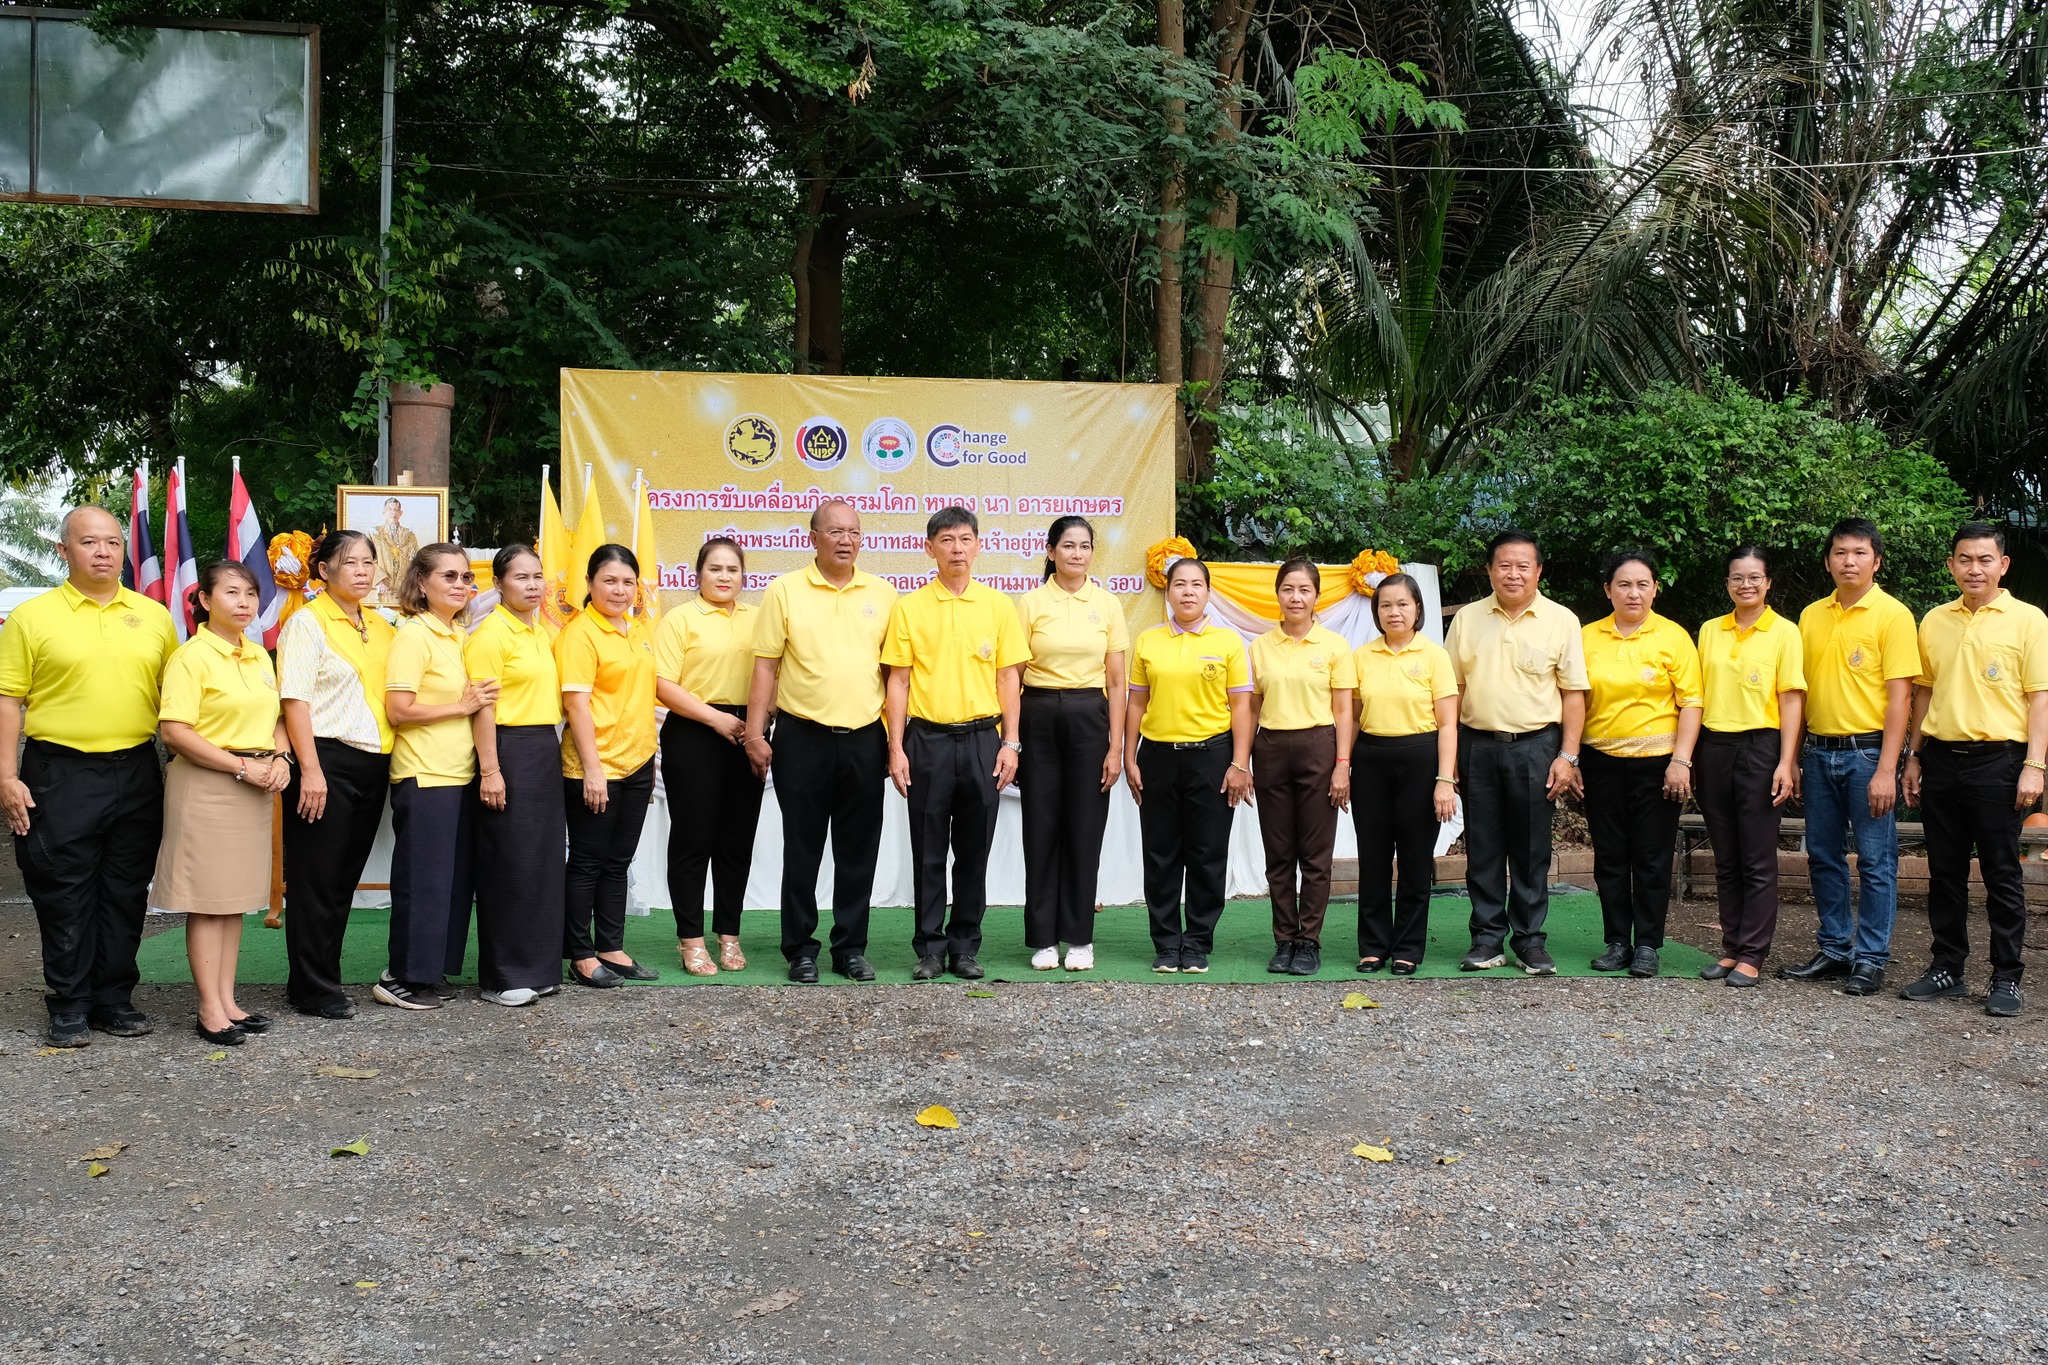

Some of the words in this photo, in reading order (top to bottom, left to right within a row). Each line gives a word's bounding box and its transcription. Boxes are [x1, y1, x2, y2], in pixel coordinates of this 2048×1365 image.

[963, 451, 983, 463] for
[988, 451, 1026, 464] Good
[985, 498, 1008, 512] นา
[1018, 497, 1122, 514] อารยเกษตร
[1109, 577, 1142, 591] รอบ
